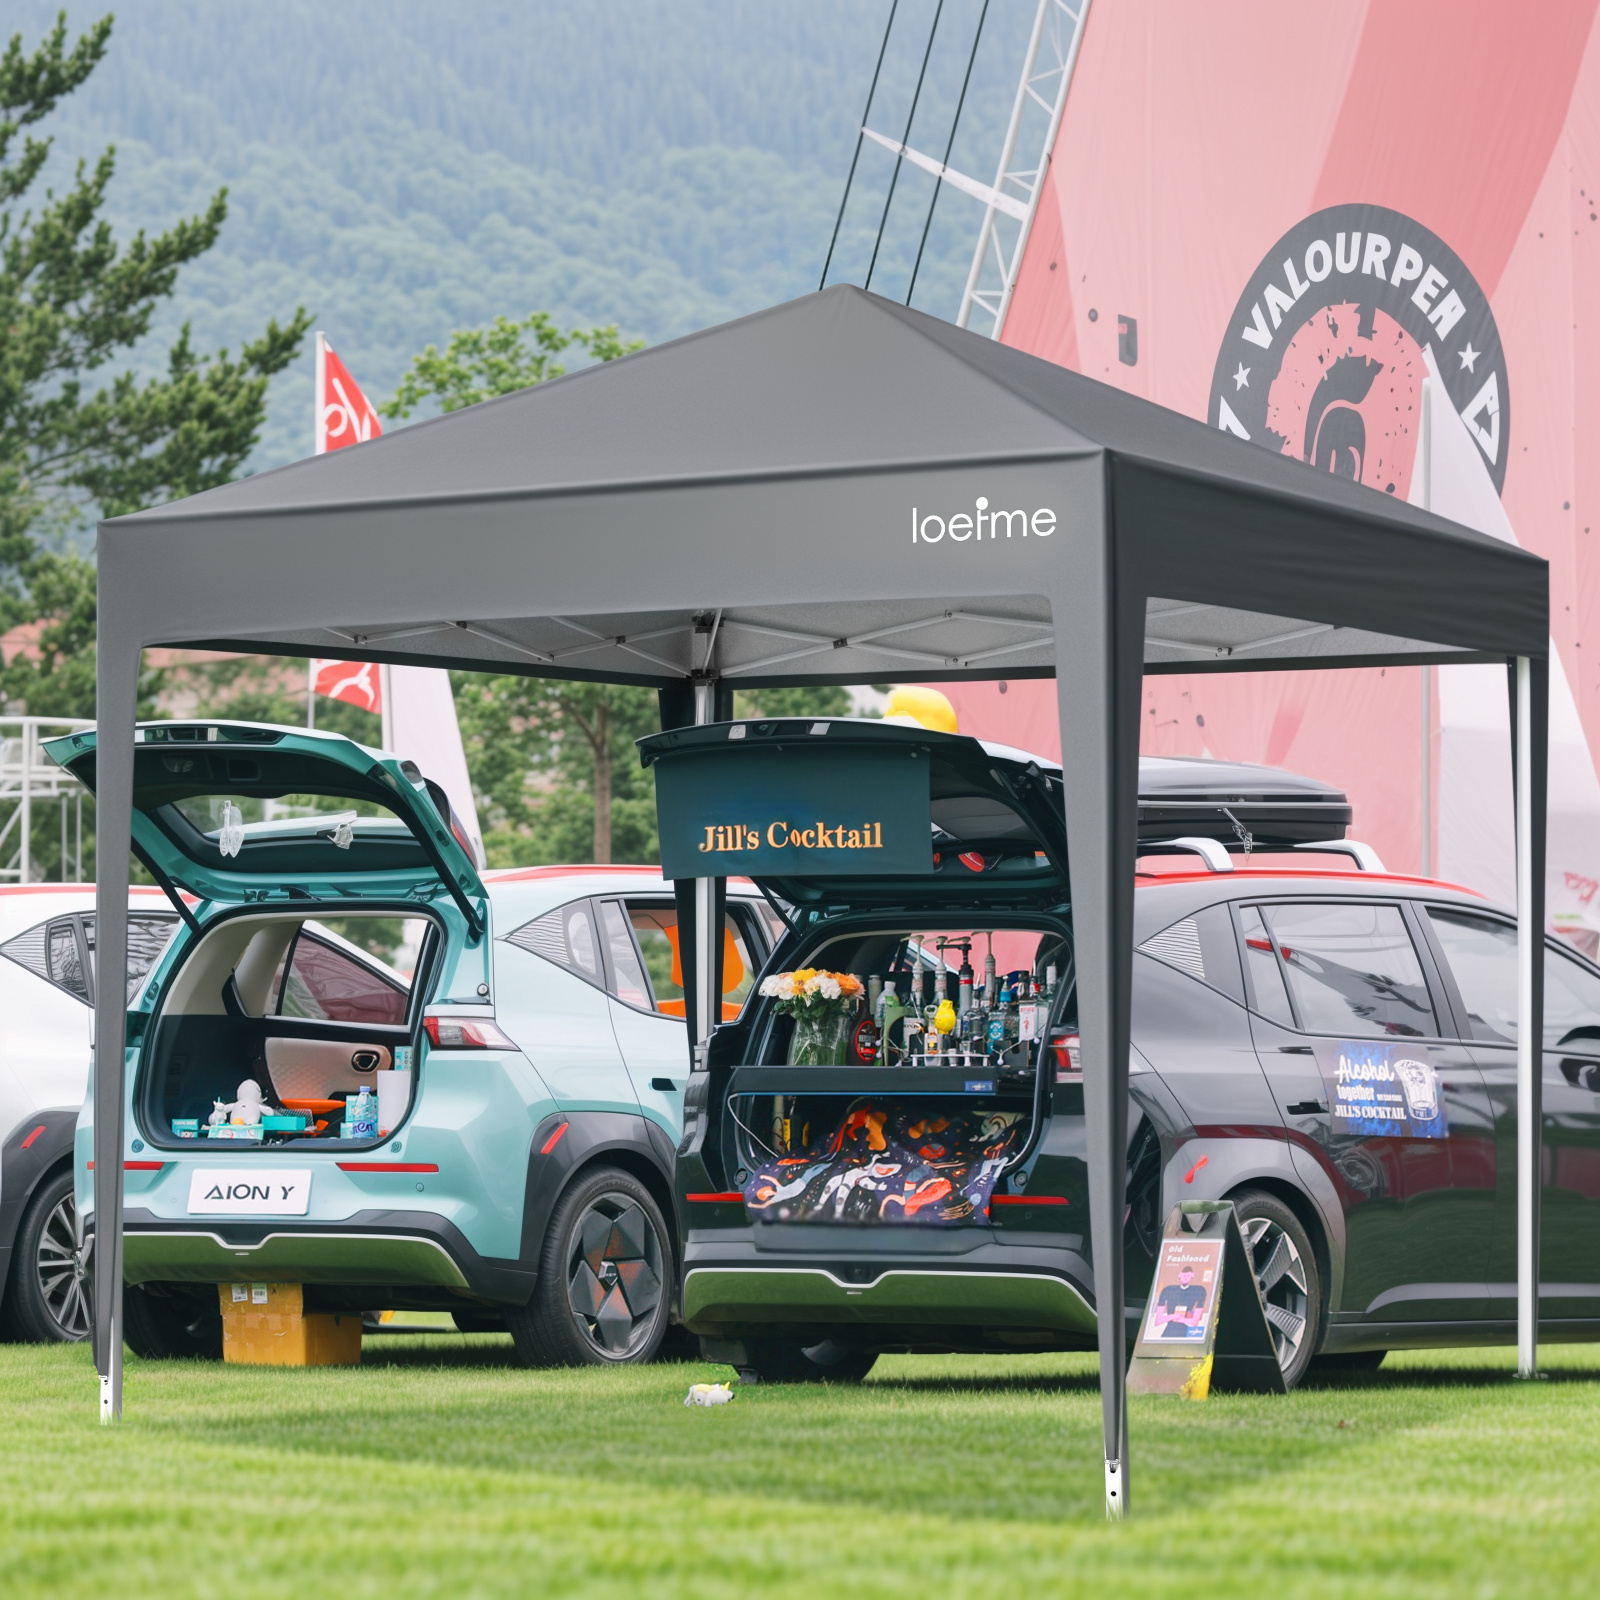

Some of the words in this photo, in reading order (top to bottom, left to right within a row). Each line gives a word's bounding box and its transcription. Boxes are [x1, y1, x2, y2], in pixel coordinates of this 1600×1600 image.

[698, 824, 760, 852] Jill's
[767, 822, 883, 848] Cocktail
[1334, 1055, 1395, 1084] Alcohol
[1335, 1104, 1361, 1118] JILL'S
[1361, 1105, 1407, 1120] COCKTAIL
[204, 1184, 270, 1200] AION
[281, 1186, 295, 1200] Y
[1168, 1245, 1184, 1253] Old
[1166, 1254, 1210, 1263] Fashioned
